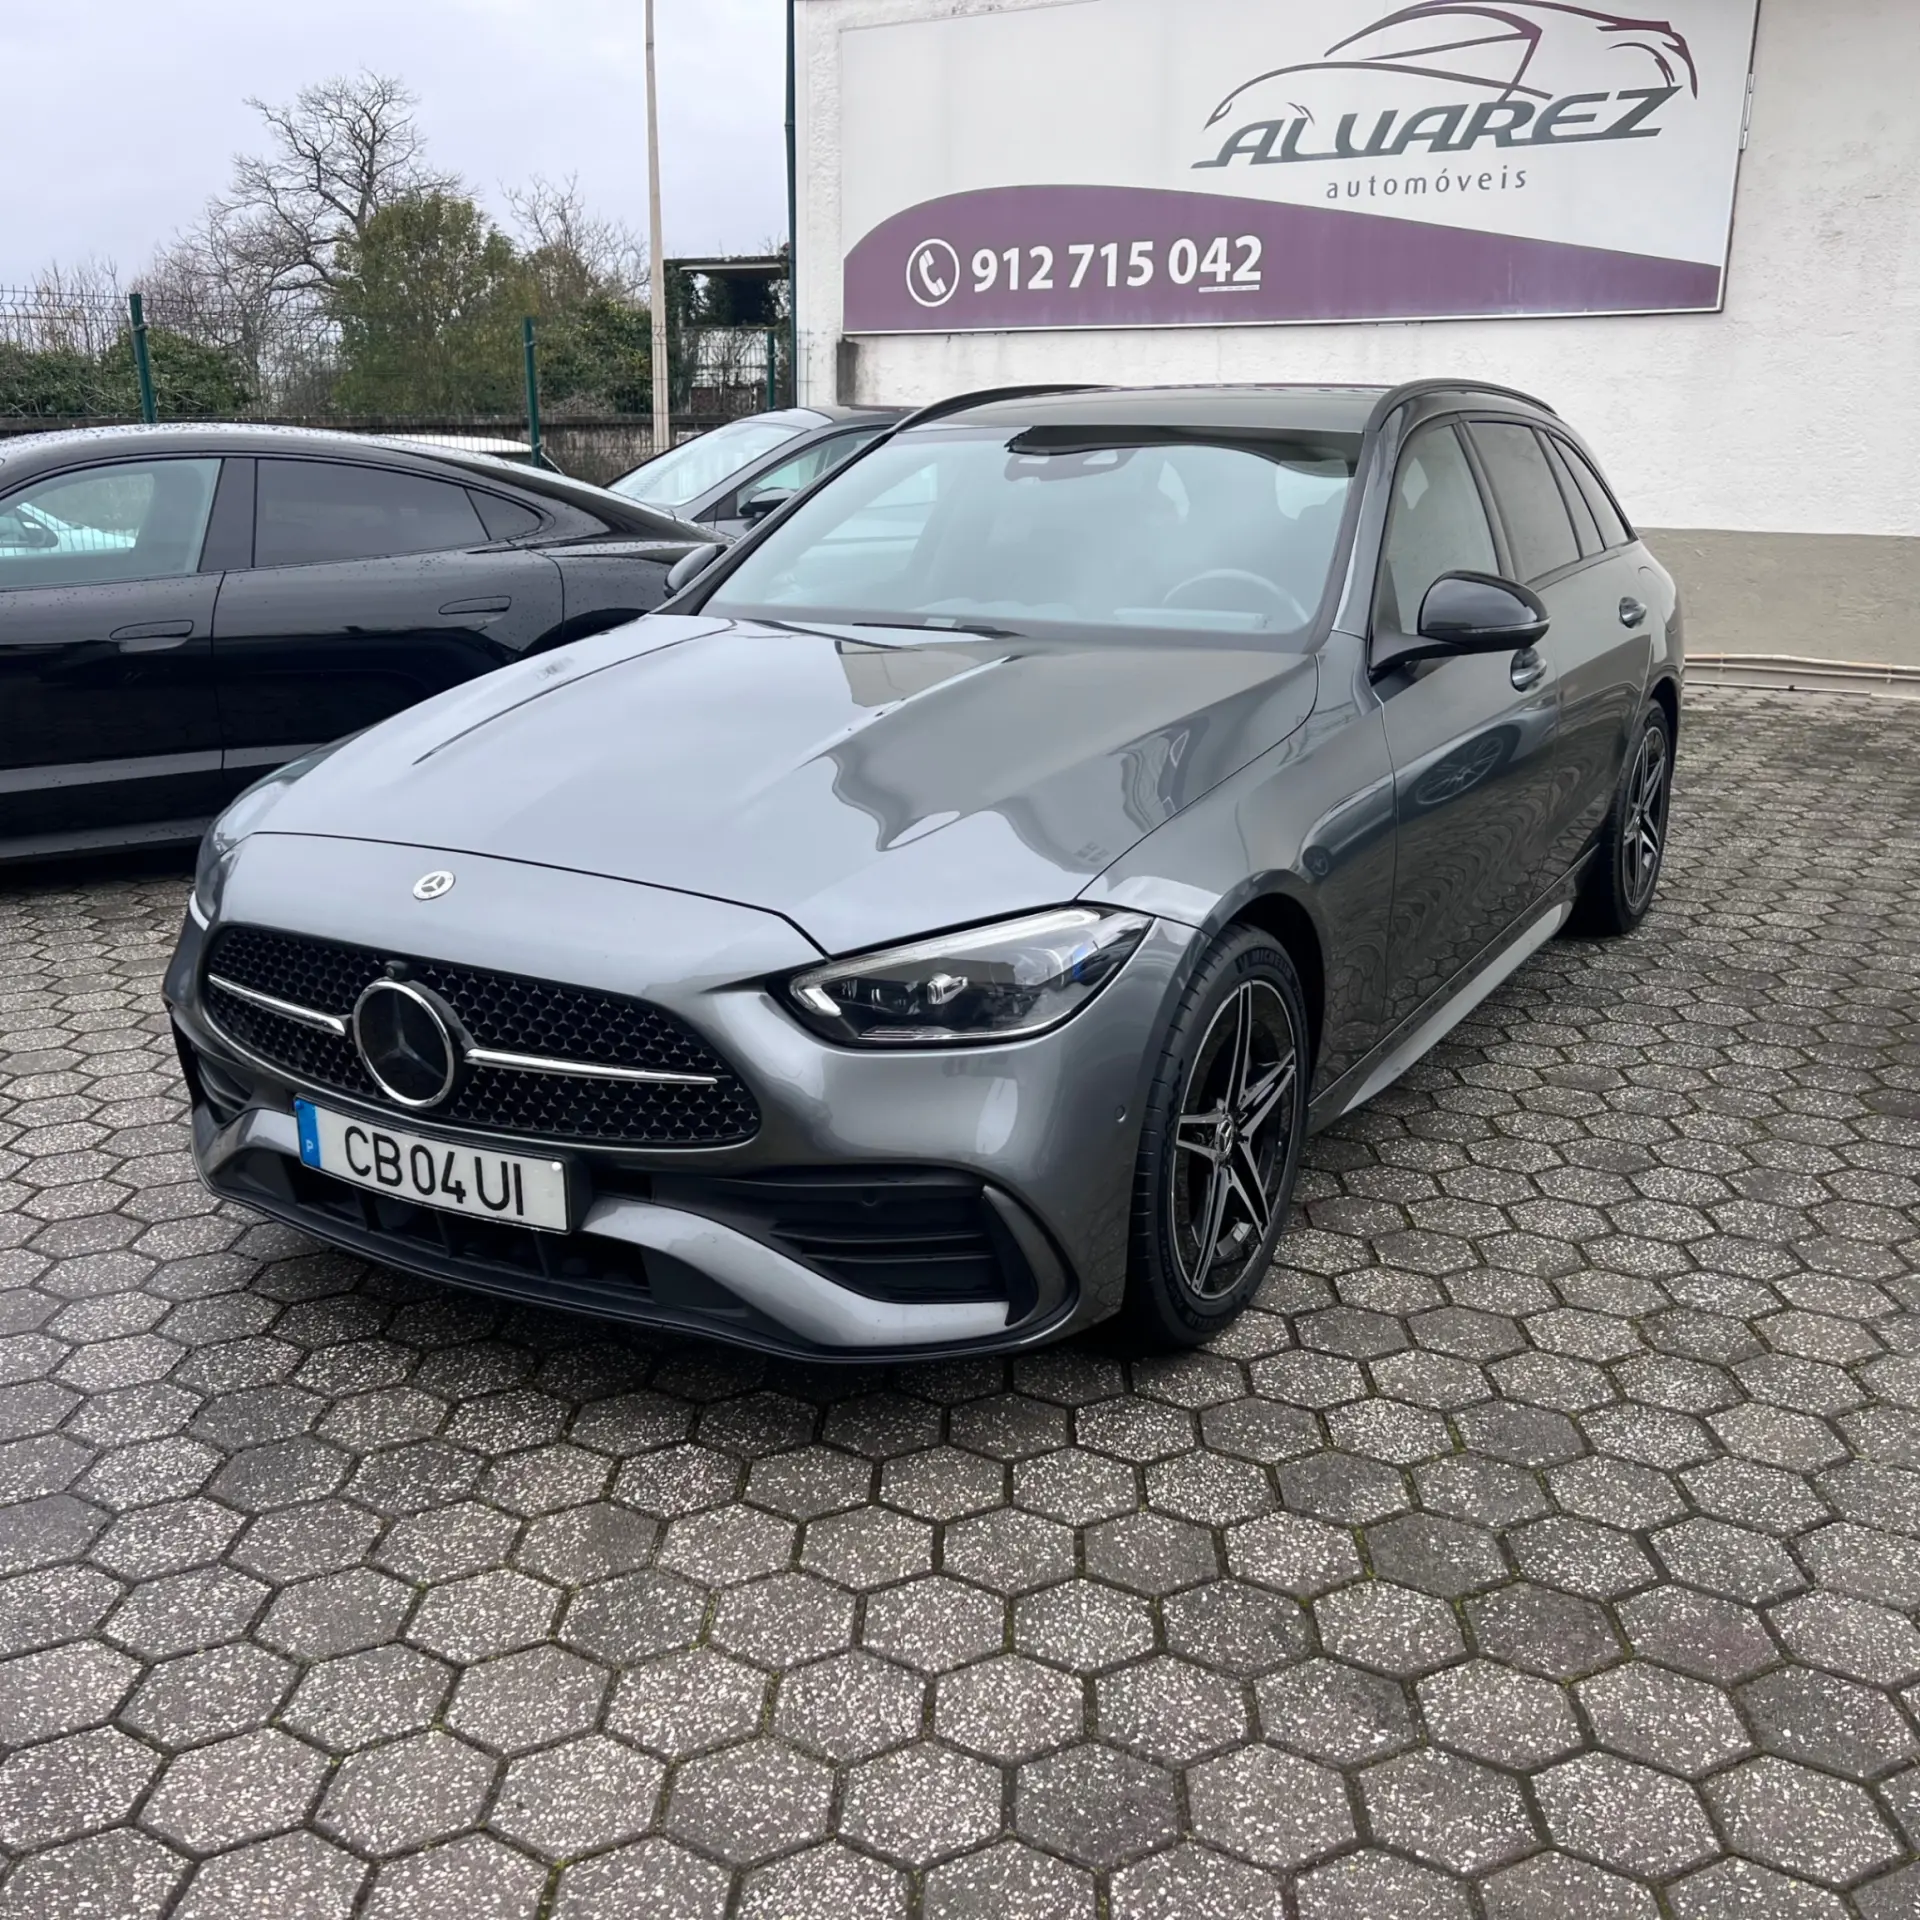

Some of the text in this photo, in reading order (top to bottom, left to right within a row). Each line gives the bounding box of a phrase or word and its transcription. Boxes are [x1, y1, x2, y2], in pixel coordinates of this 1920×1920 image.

[1326, 165, 1527, 199] automóveis
[971, 235, 1263, 293] 912 715 042
[305, 1139, 314, 1153] P
